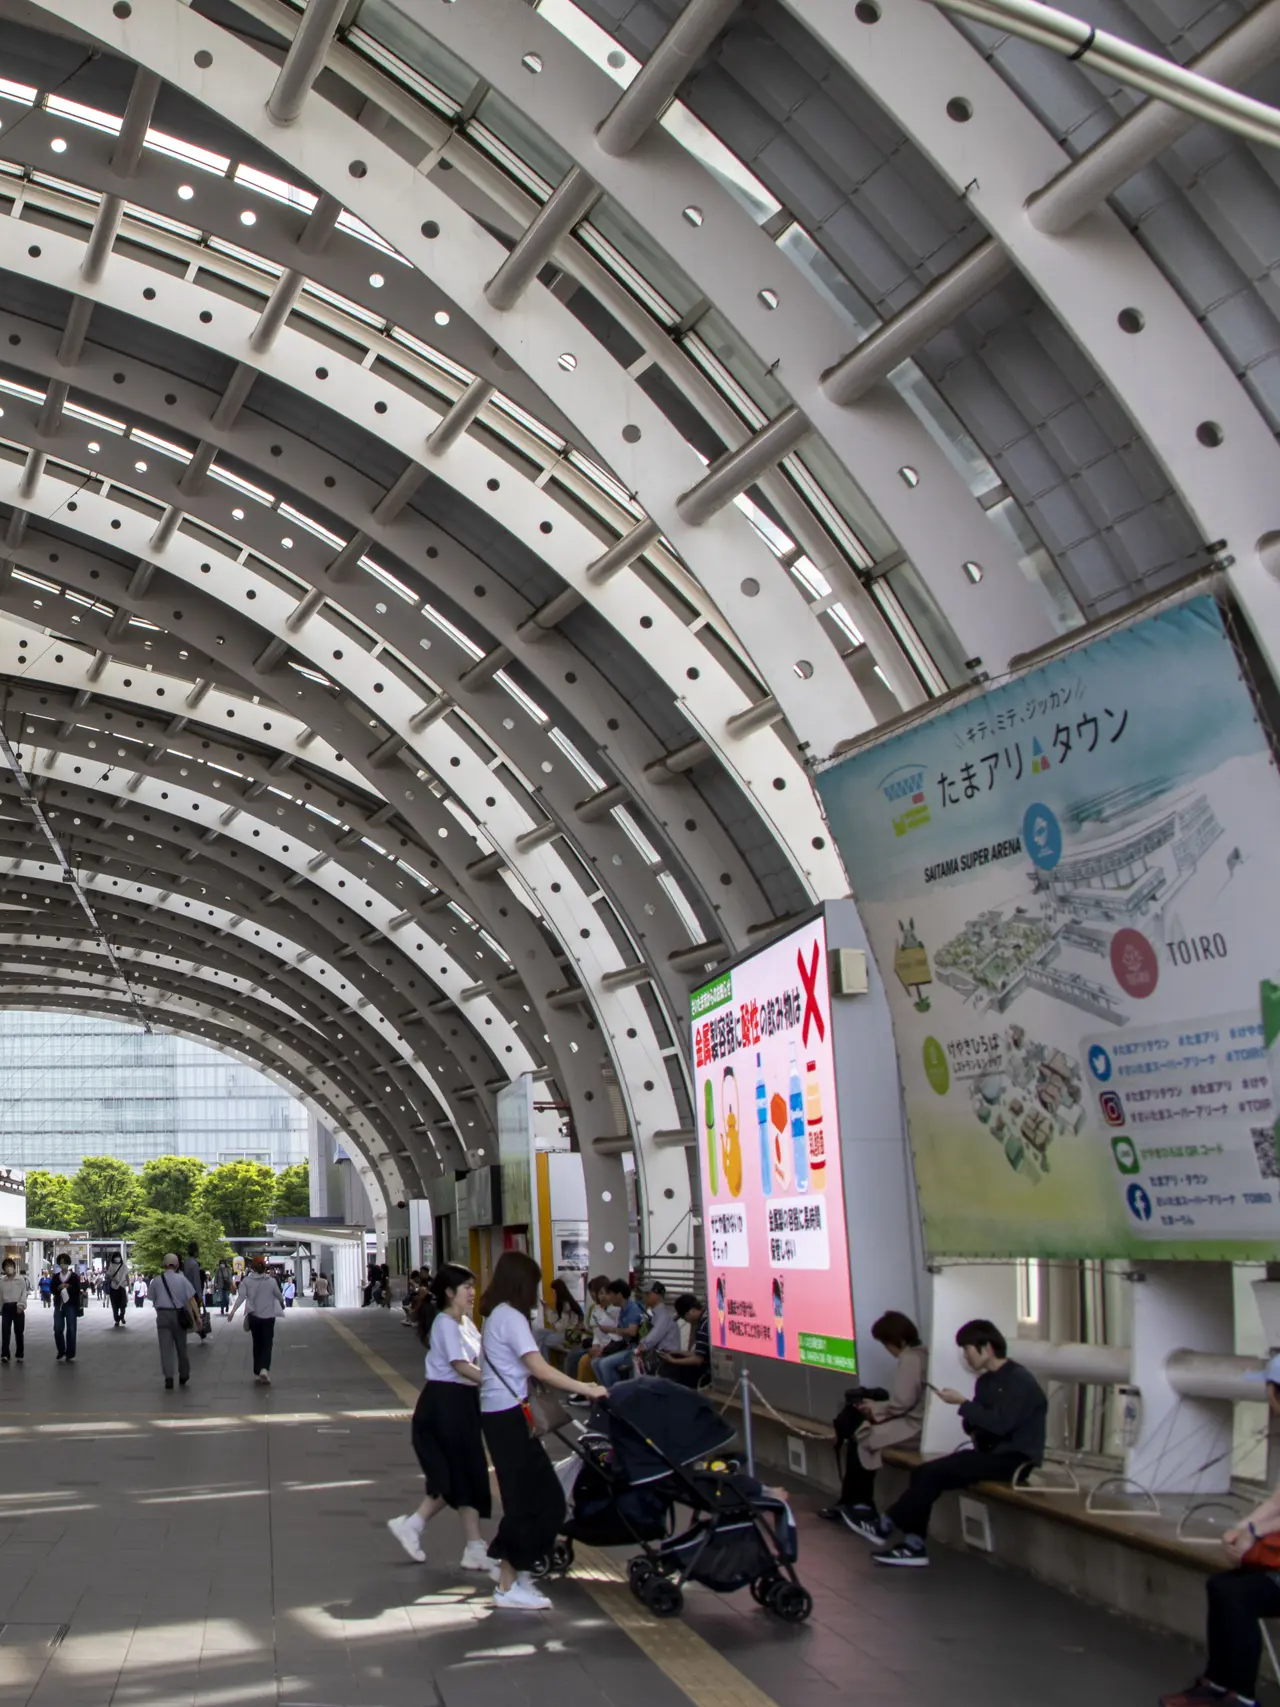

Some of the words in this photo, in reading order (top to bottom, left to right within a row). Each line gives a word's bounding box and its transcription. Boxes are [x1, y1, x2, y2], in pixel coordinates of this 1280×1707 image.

[924, 859, 960, 883] SAITAMA
[960, 848, 991, 871] SUPER
[990, 837, 1022, 863] ARENA
[1166, 932, 1227, 966] TOIRO
